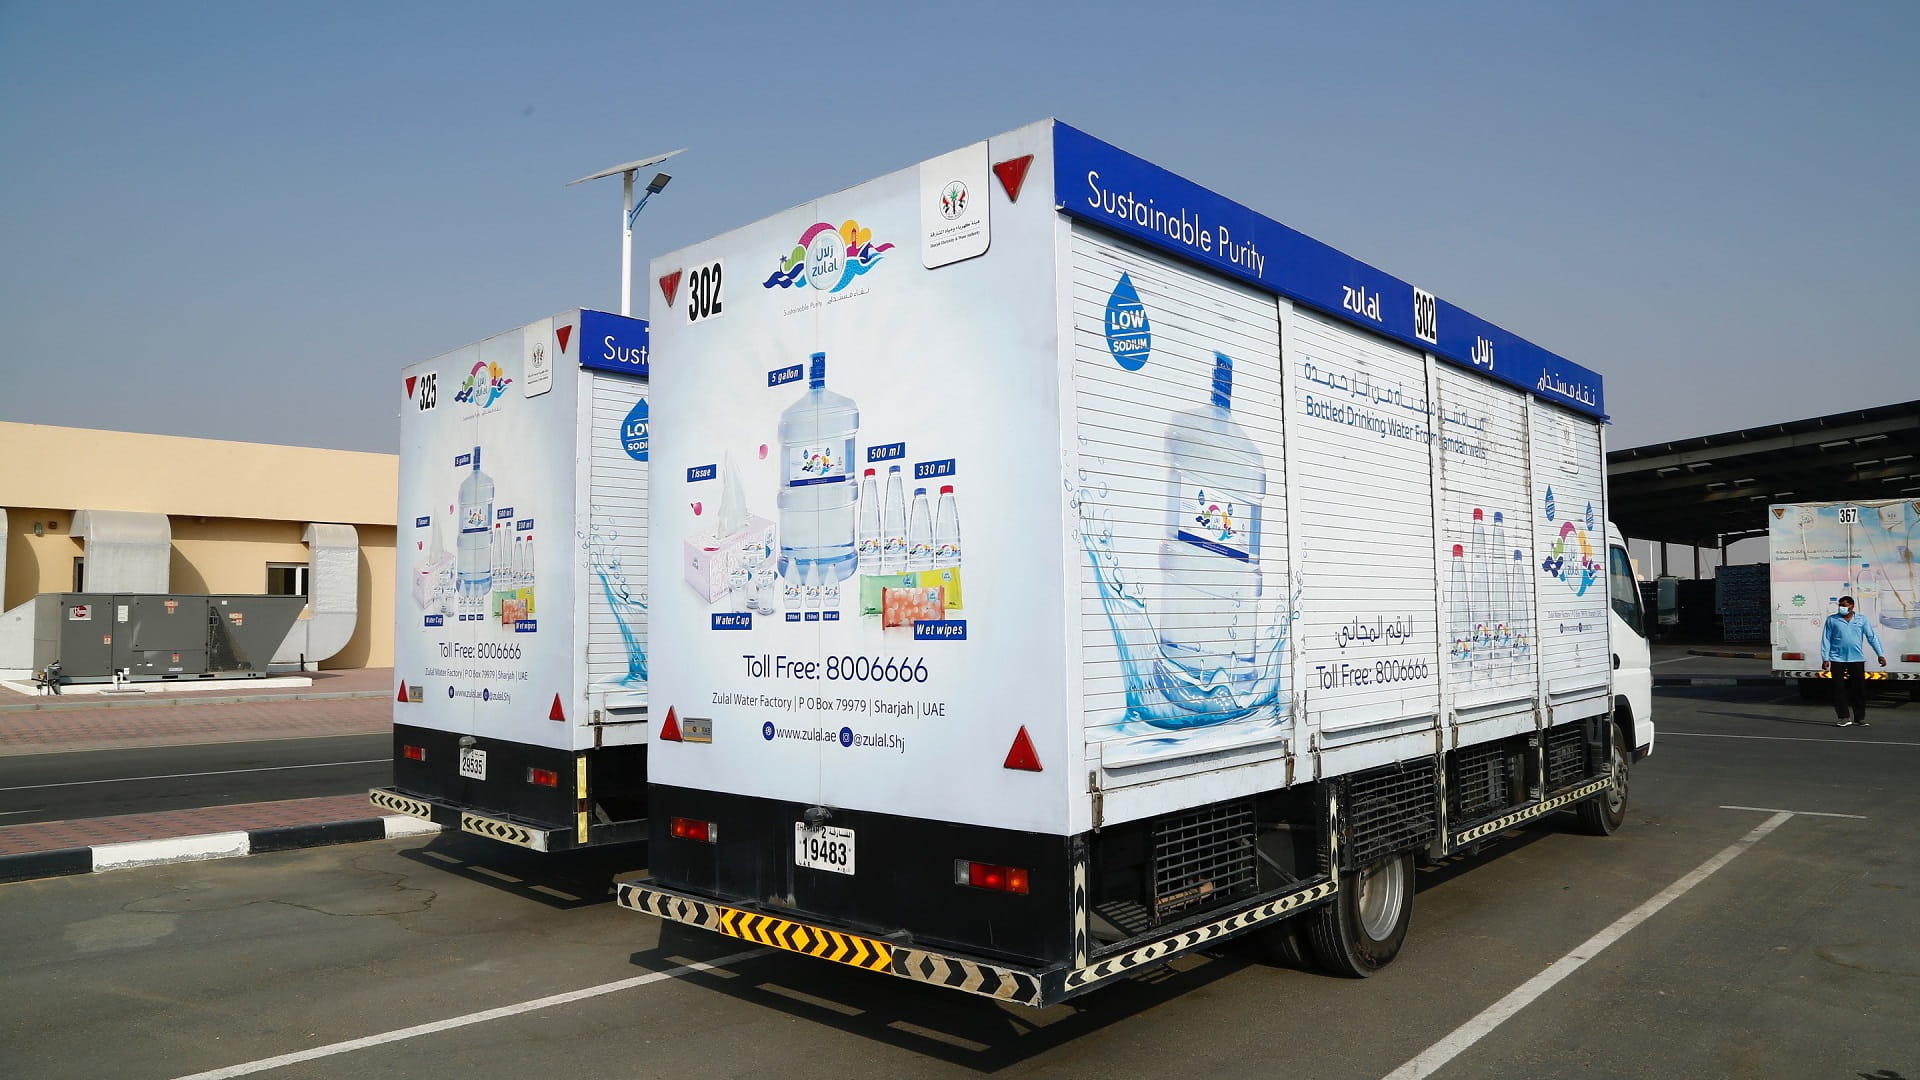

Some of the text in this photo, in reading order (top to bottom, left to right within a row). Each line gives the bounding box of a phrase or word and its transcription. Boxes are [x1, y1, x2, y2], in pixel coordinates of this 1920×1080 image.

[1087, 170, 1265, 278] Sustainable Purity
[816, 245, 834, 262] زلال
[812, 258, 838, 277] zulal
[689, 262, 722, 321] 302
[1343, 284, 1382, 323] zulal
[1111, 310, 1144, 330] LOW
[1415, 291, 1436, 344] 302
[1113, 338, 1147, 352] SODIUM
[1471, 335, 1494, 371] زلال
[771, 368, 799, 384] 5 gallon
[419, 373, 437, 411] 325
[1306, 395, 1344, 423] Bottled
[1347, 406, 1386, 438] Drinking
[1388, 416, 1414, 440] Water
[1415, 425, 1438, 446] From
[1442, 435, 1468, 456] amdah
[871, 445, 902, 459] 500 ml
[691, 467, 711, 478] Tissue
[918, 462, 950, 476] 330 ml
[1839, 509, 1857, 523] 367
[715, 615, 750, 627] Water Cup
[916, 624, 963, 637] Wet wipes
[1386, 615, 1413, 646] الرقم
[438, 642, 522, 660] Toll Free: 8006666
[447, 669, 462, 679] Factory
[498, 670, 515, 681] Sharjah
[518, 671, 528, 681] UAE
[743, 654, 928, 683] Toll Free: 8006666
[1315, 657, 1428, 690] Toll Free: 8006666
[712, 692, 732, 705] Zulal
[734, 694, 758, 707] Water
[759, 695, 792, 711] Factory
[799, 697, 805, 709] P
[806, 697, 815, 710] O
[816, 698, 834, 711] Box
[836, 698, 867, 713] 79979
[874, 700, 914, 718] Sharjah
[922, 702, 945, 717] UAE
[776, 725, 905, 753] www.zulal.ae @zulal.Shj
[463, 756, 483, 775] 29535
[821, 826, 827, 839] 2
[803, 838, 847, 866] 19483
